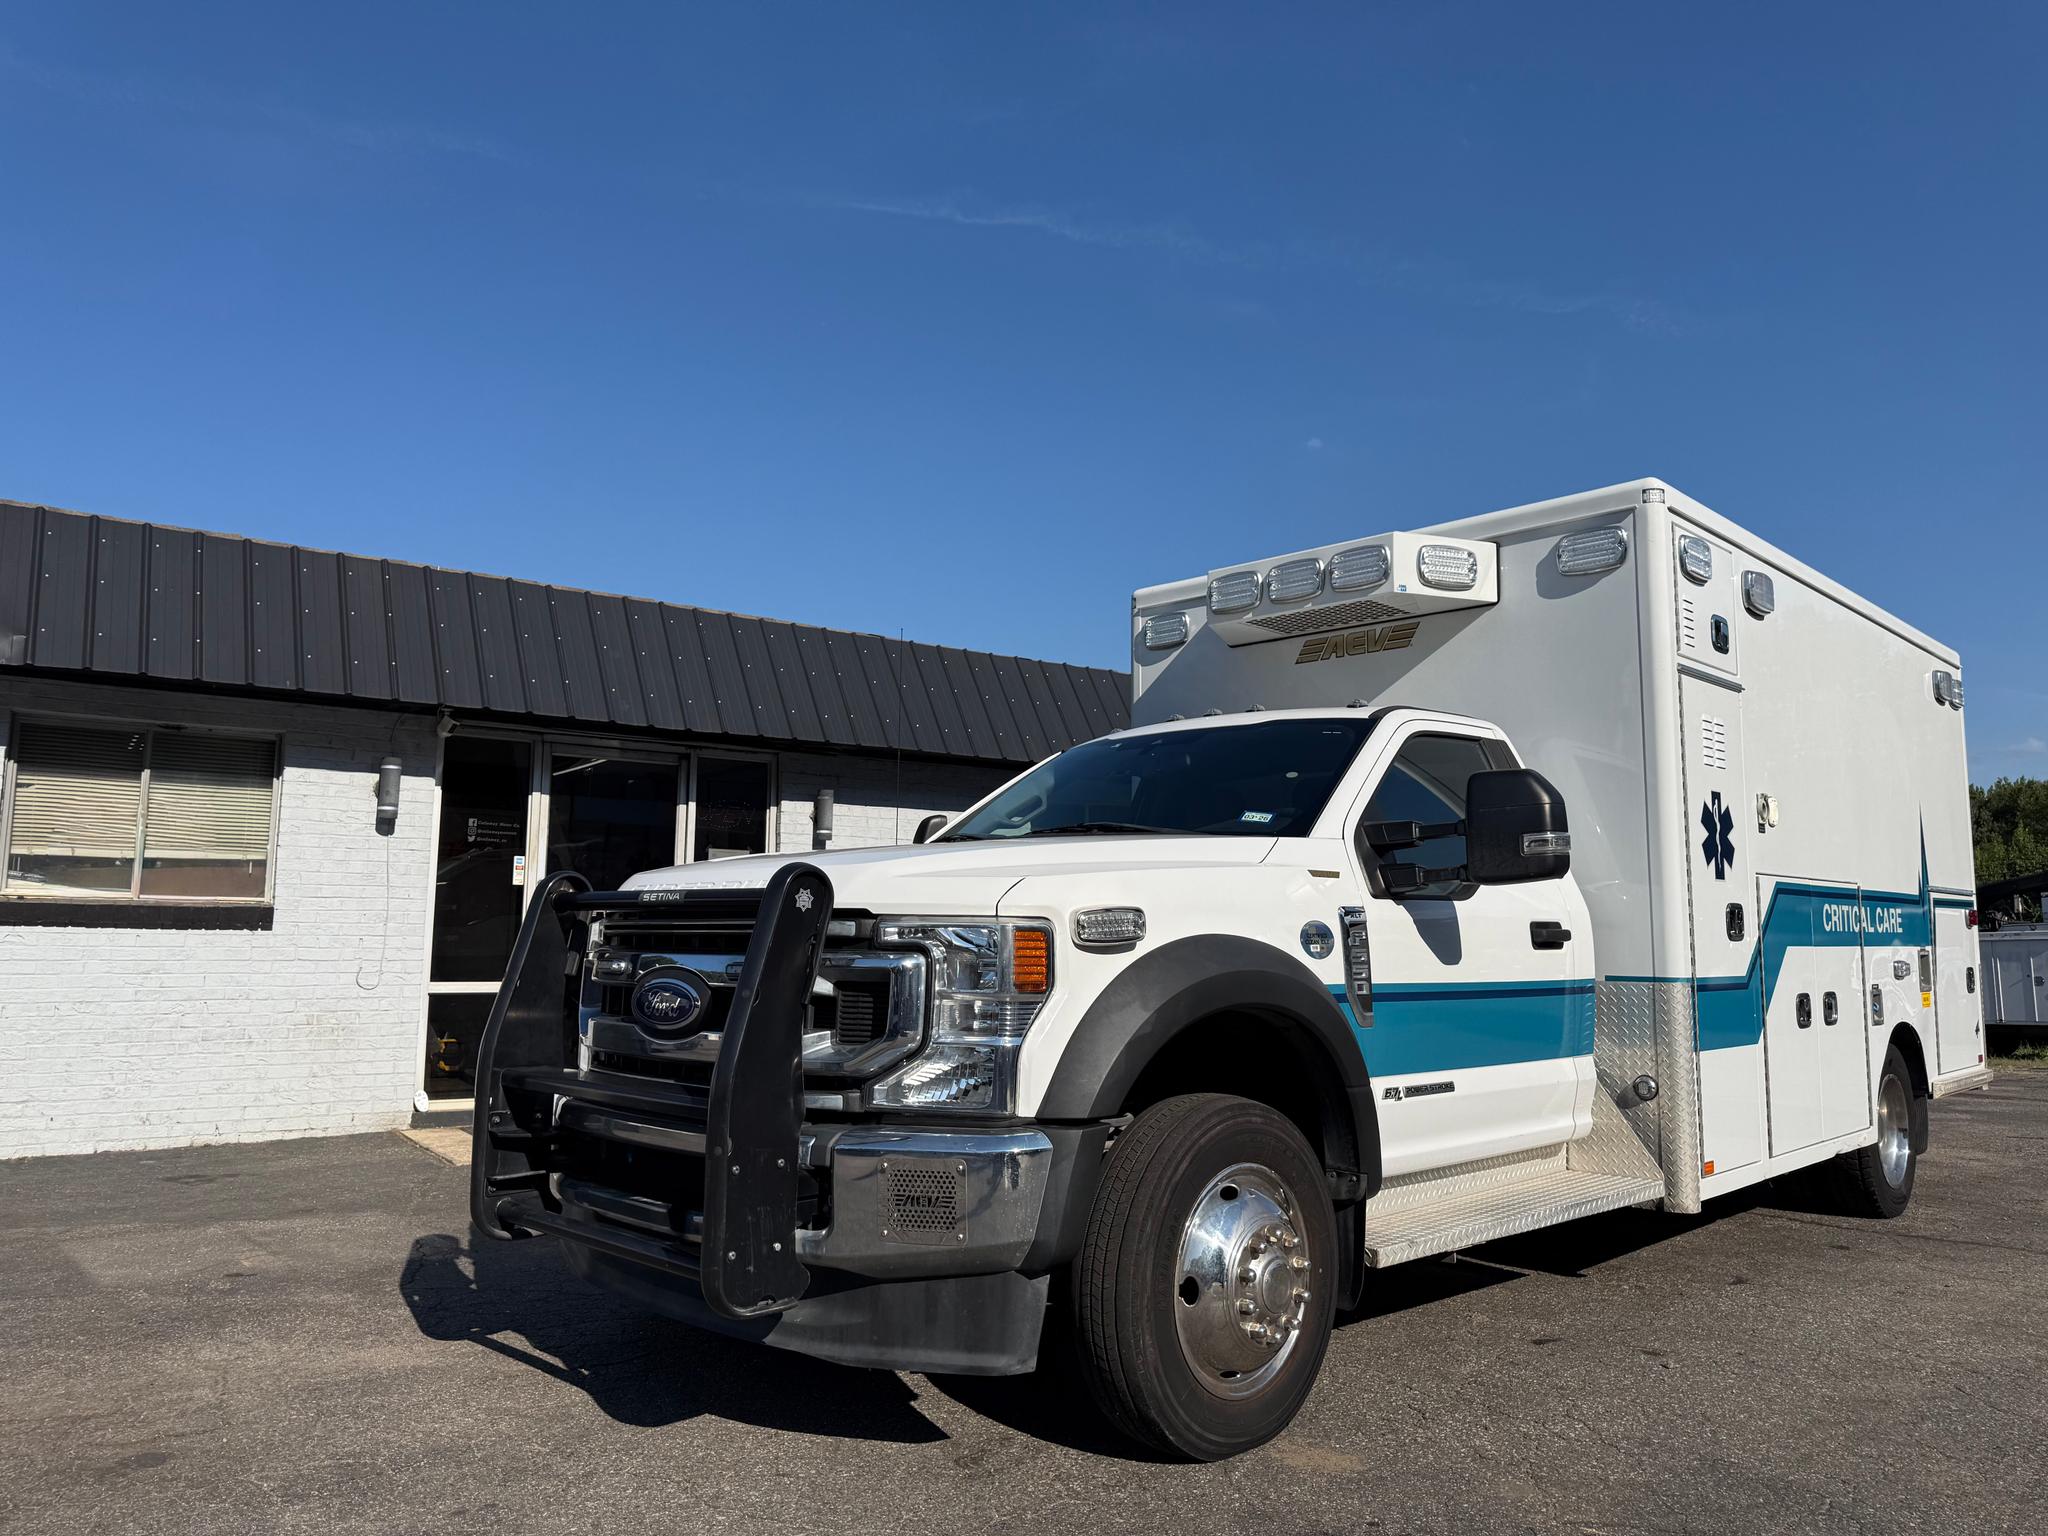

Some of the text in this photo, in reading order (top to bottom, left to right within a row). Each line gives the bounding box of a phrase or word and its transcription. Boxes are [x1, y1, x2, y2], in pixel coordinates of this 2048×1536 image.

[1314, 625, 1397, 661] AEV
[643, 892, 680, 902] SETINA
[1822, 903, 1903, 933] CRITICAL CARE
[643, 988, 681, 1017] Ford
